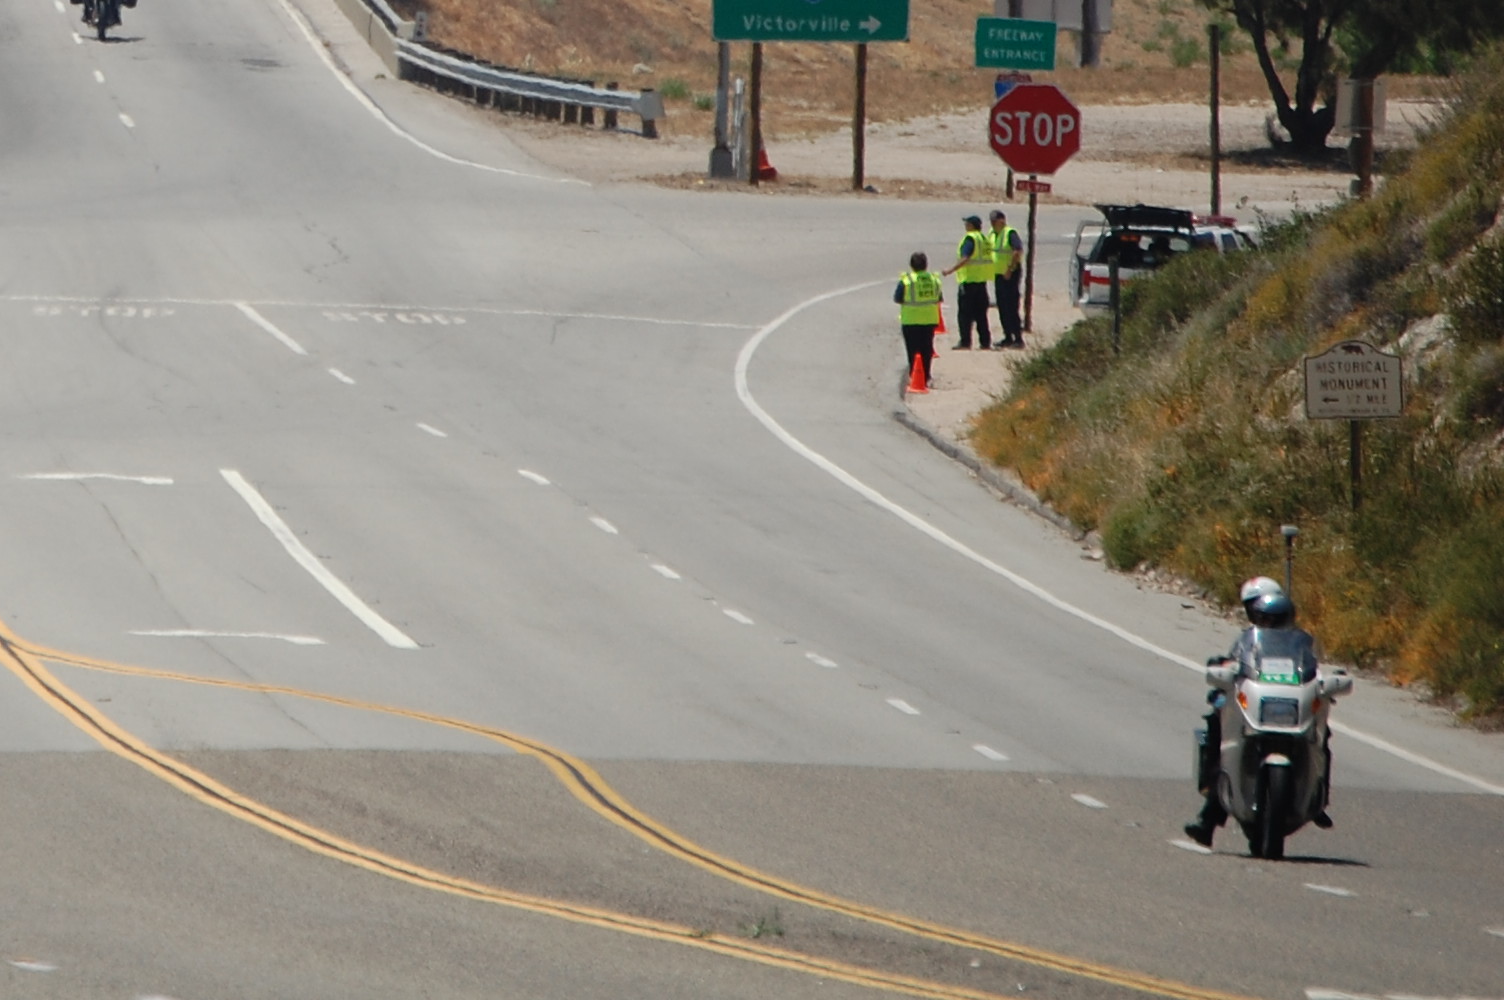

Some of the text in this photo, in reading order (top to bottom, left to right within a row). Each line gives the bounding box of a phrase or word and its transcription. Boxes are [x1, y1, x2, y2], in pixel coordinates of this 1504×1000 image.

[742, 15, 851, 32] Victorville
[988, 28, 1044, 42] FREEWAY
[983, 48, 1046, 63] ENTRANCE
[994, 111, 1076, 147] STOP
[1316, 361, 1389, 373] HISTORICAL
[1319, 378, 1388, 391] MONUMENT
